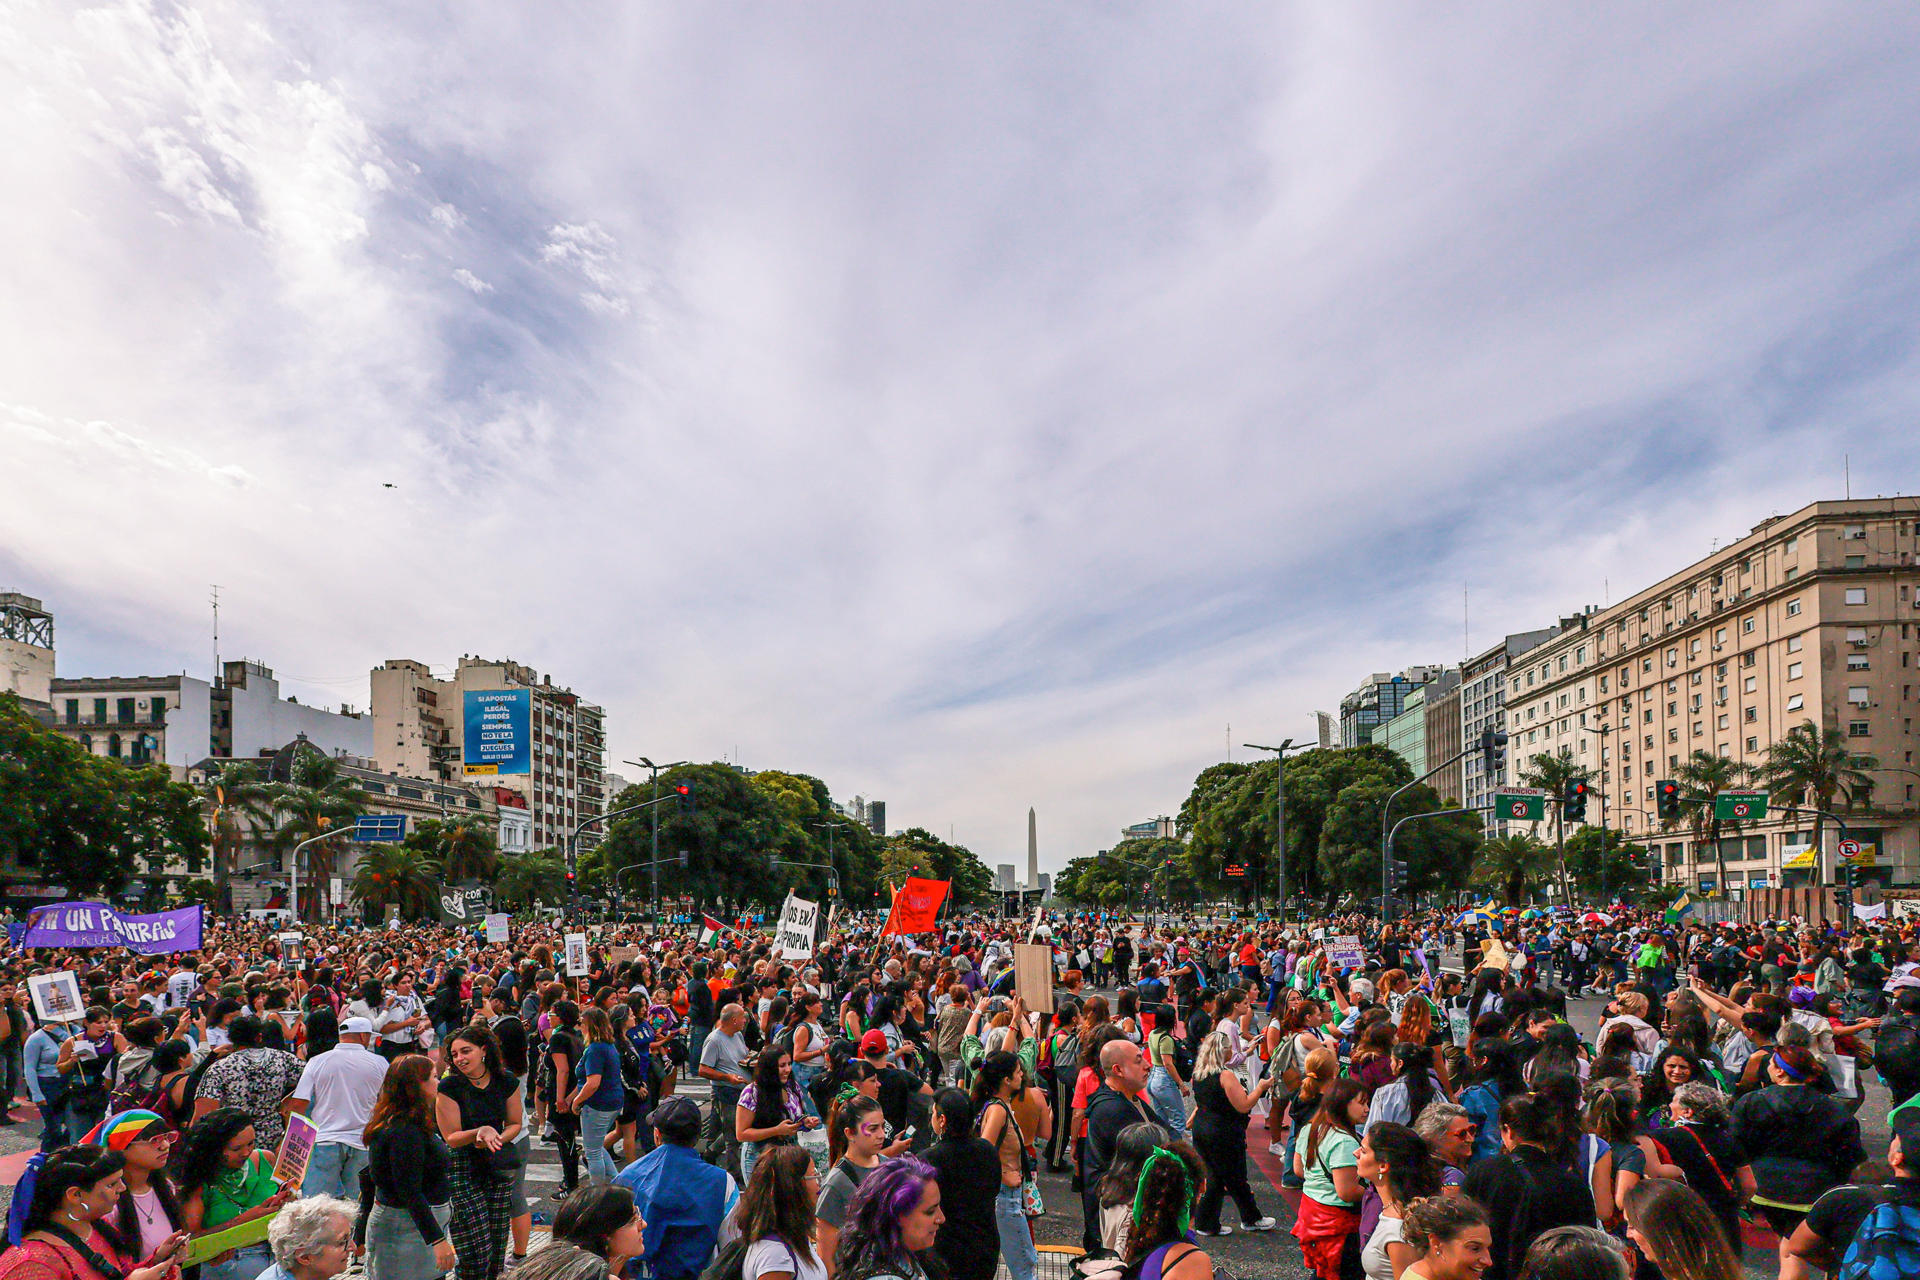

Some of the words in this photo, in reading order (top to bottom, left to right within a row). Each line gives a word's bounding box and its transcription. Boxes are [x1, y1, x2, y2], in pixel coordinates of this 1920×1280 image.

[484, 694, 517, 702] APOSTÁS
[483, 712, 510, 720] PERDÉS
[65, 908, 94, 932] UN
